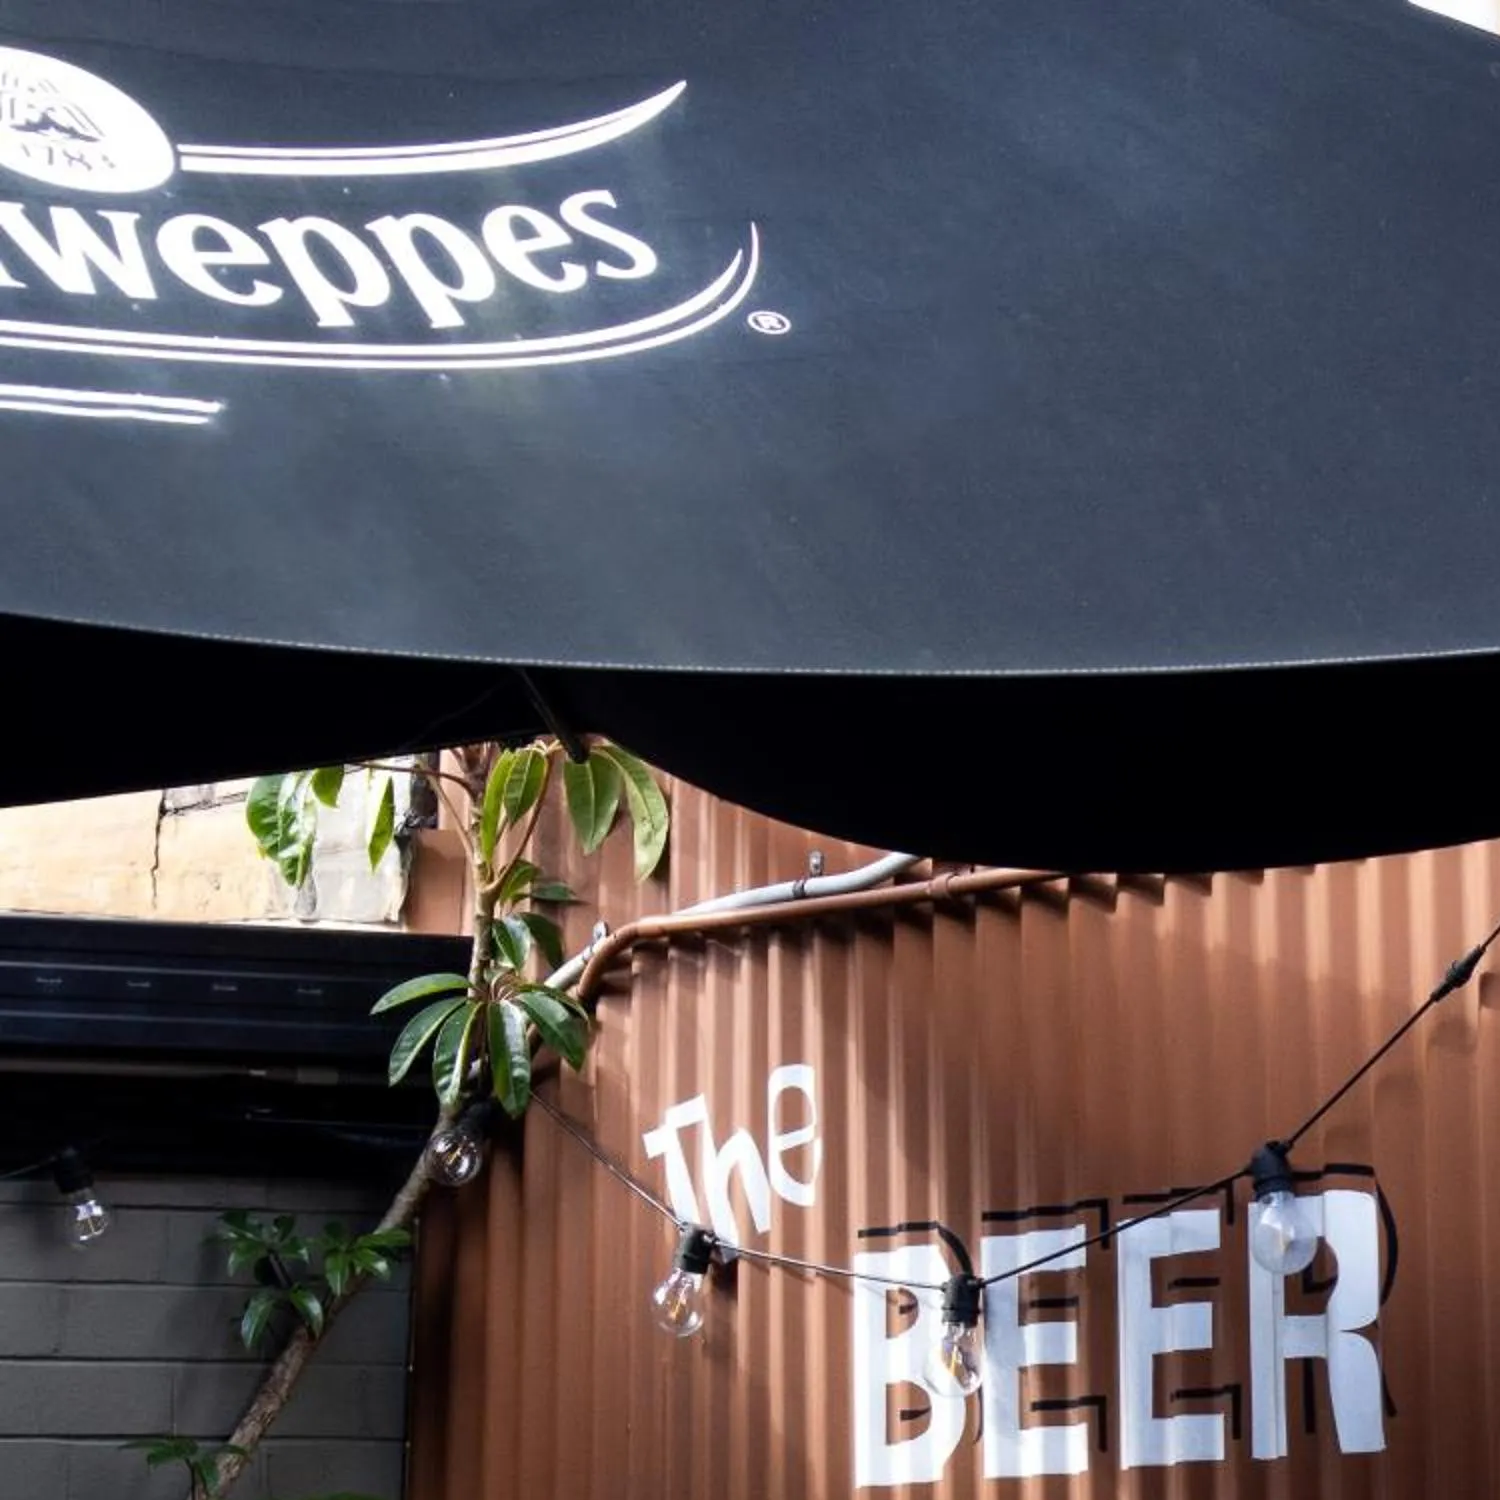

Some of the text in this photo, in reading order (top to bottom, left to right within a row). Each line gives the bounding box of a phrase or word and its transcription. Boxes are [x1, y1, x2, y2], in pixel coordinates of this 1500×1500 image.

[0, 190, 657, 328] weppes
[643, 1063, 823, 1264] The
[853, 1189, 1386, 1487] BEER
